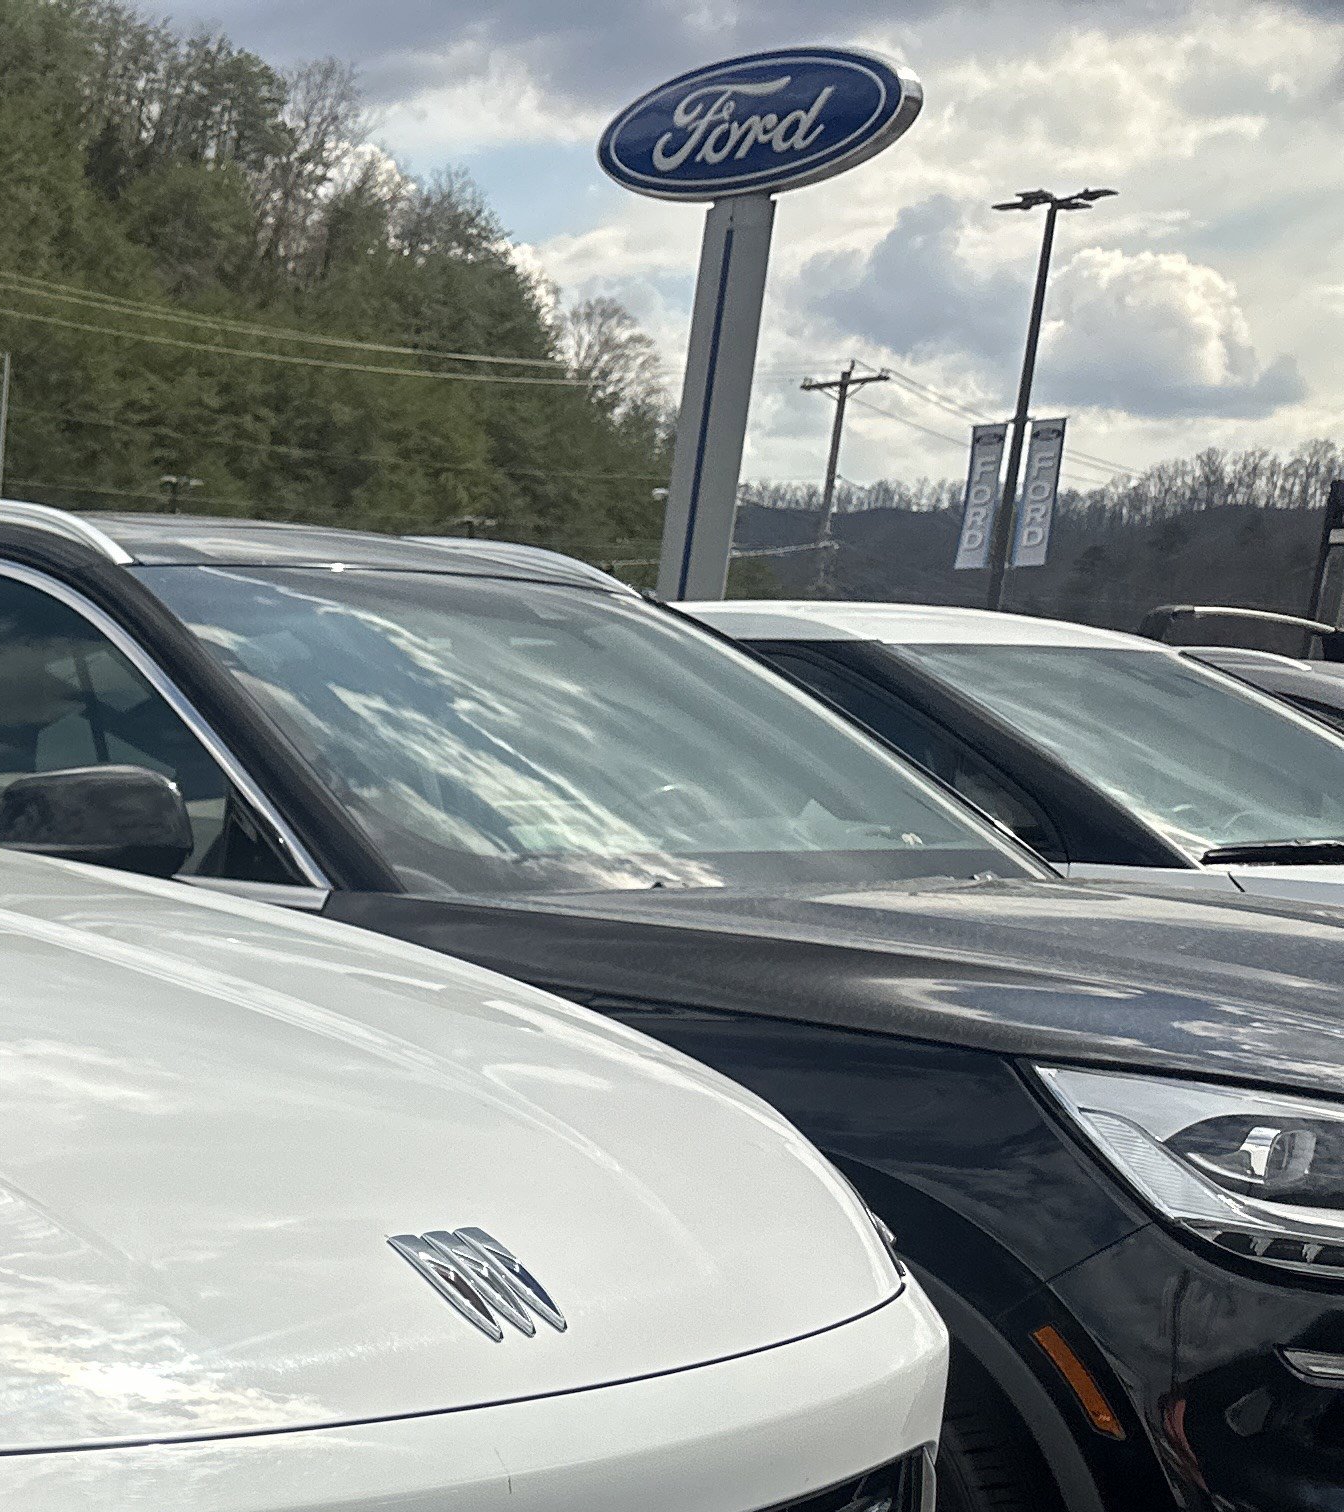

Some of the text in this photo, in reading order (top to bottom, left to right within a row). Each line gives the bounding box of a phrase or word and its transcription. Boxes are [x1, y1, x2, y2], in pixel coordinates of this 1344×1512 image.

[651, 75, 836, 173] Ford
[962, 455, 999, 551] FORD
[1020, 450, 1057, 548] FORD
